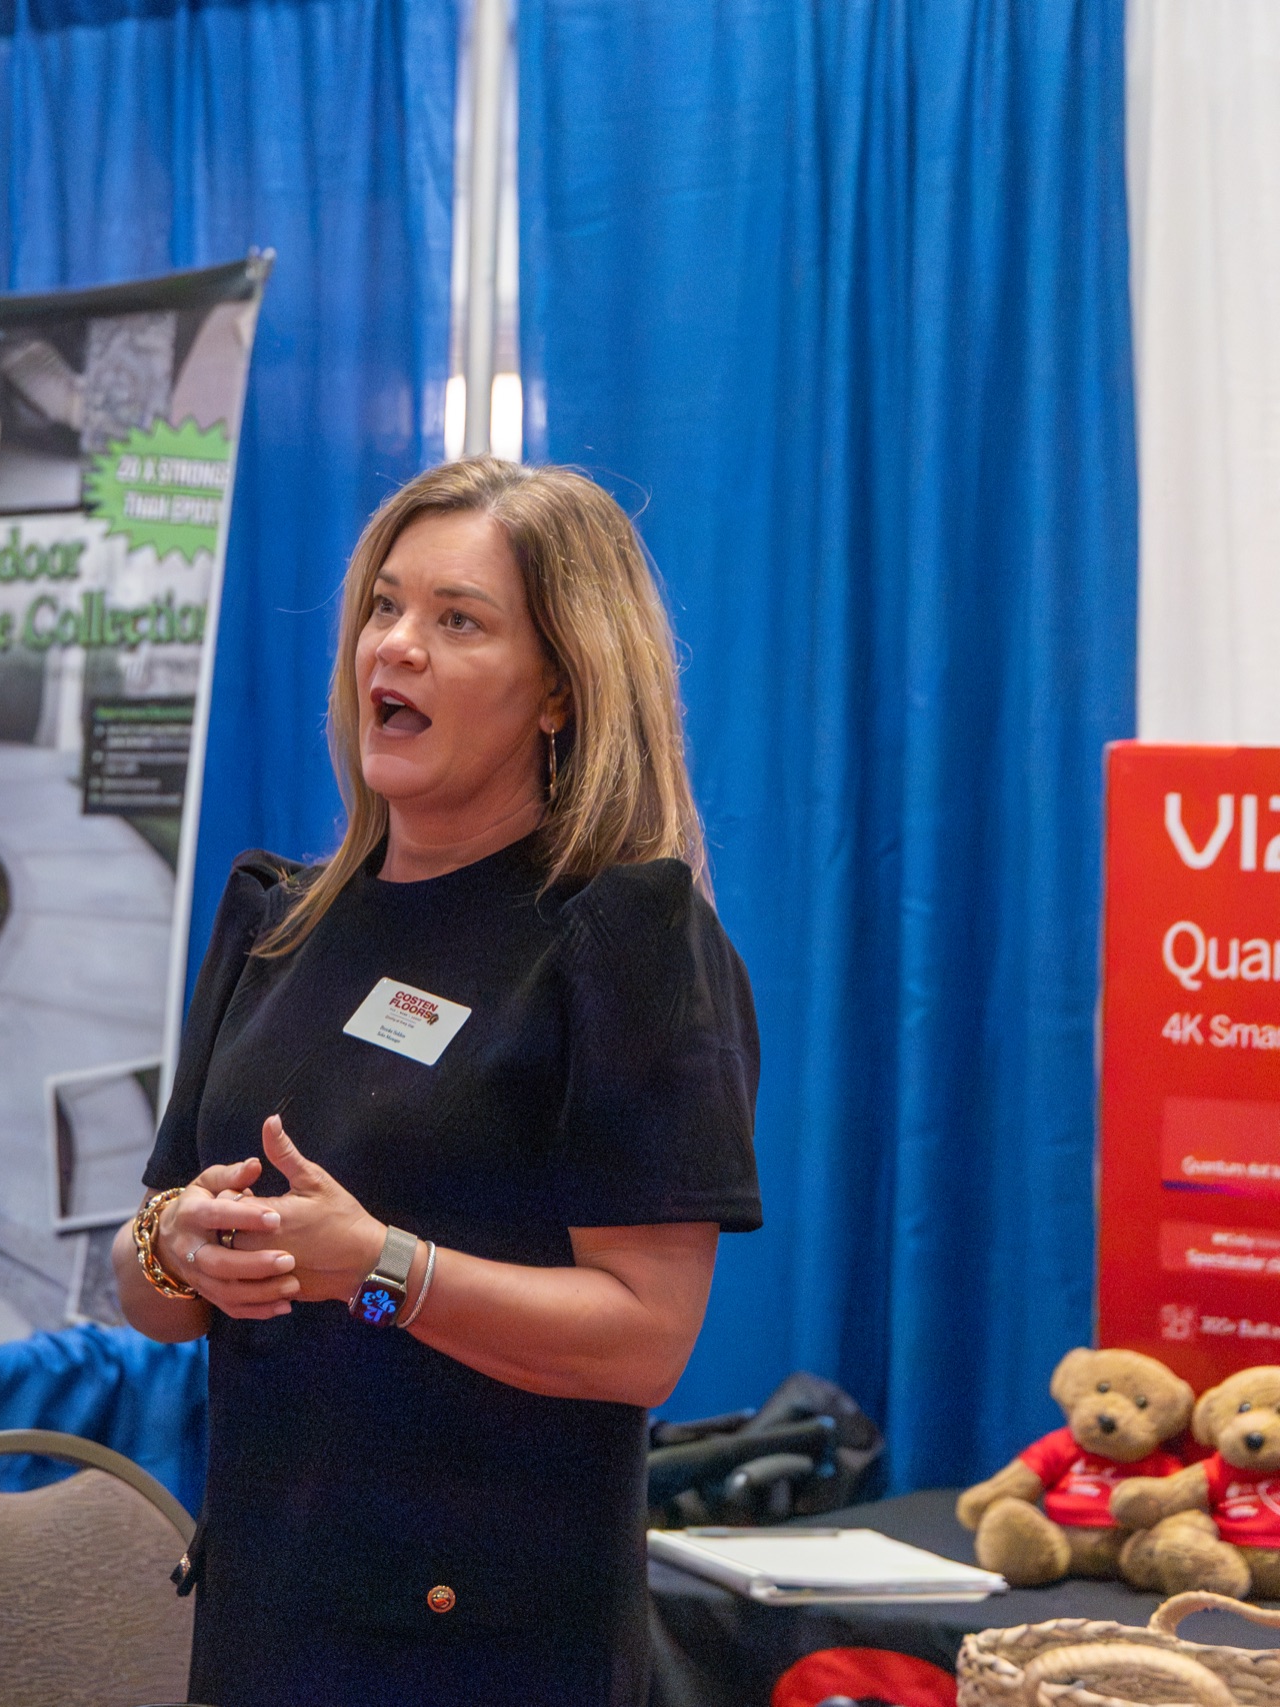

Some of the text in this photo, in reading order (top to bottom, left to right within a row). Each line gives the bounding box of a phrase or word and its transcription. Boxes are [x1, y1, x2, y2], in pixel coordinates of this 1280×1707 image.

[1164, 792, 1280, 872] VI
[1162, 920, 1280, 991] Qua
[389, 997, 433, 1019] FLOORS
[395, 991, 439, 1012] COSTEN
[1161, 1012, 1280, 1050] 4K Sma
